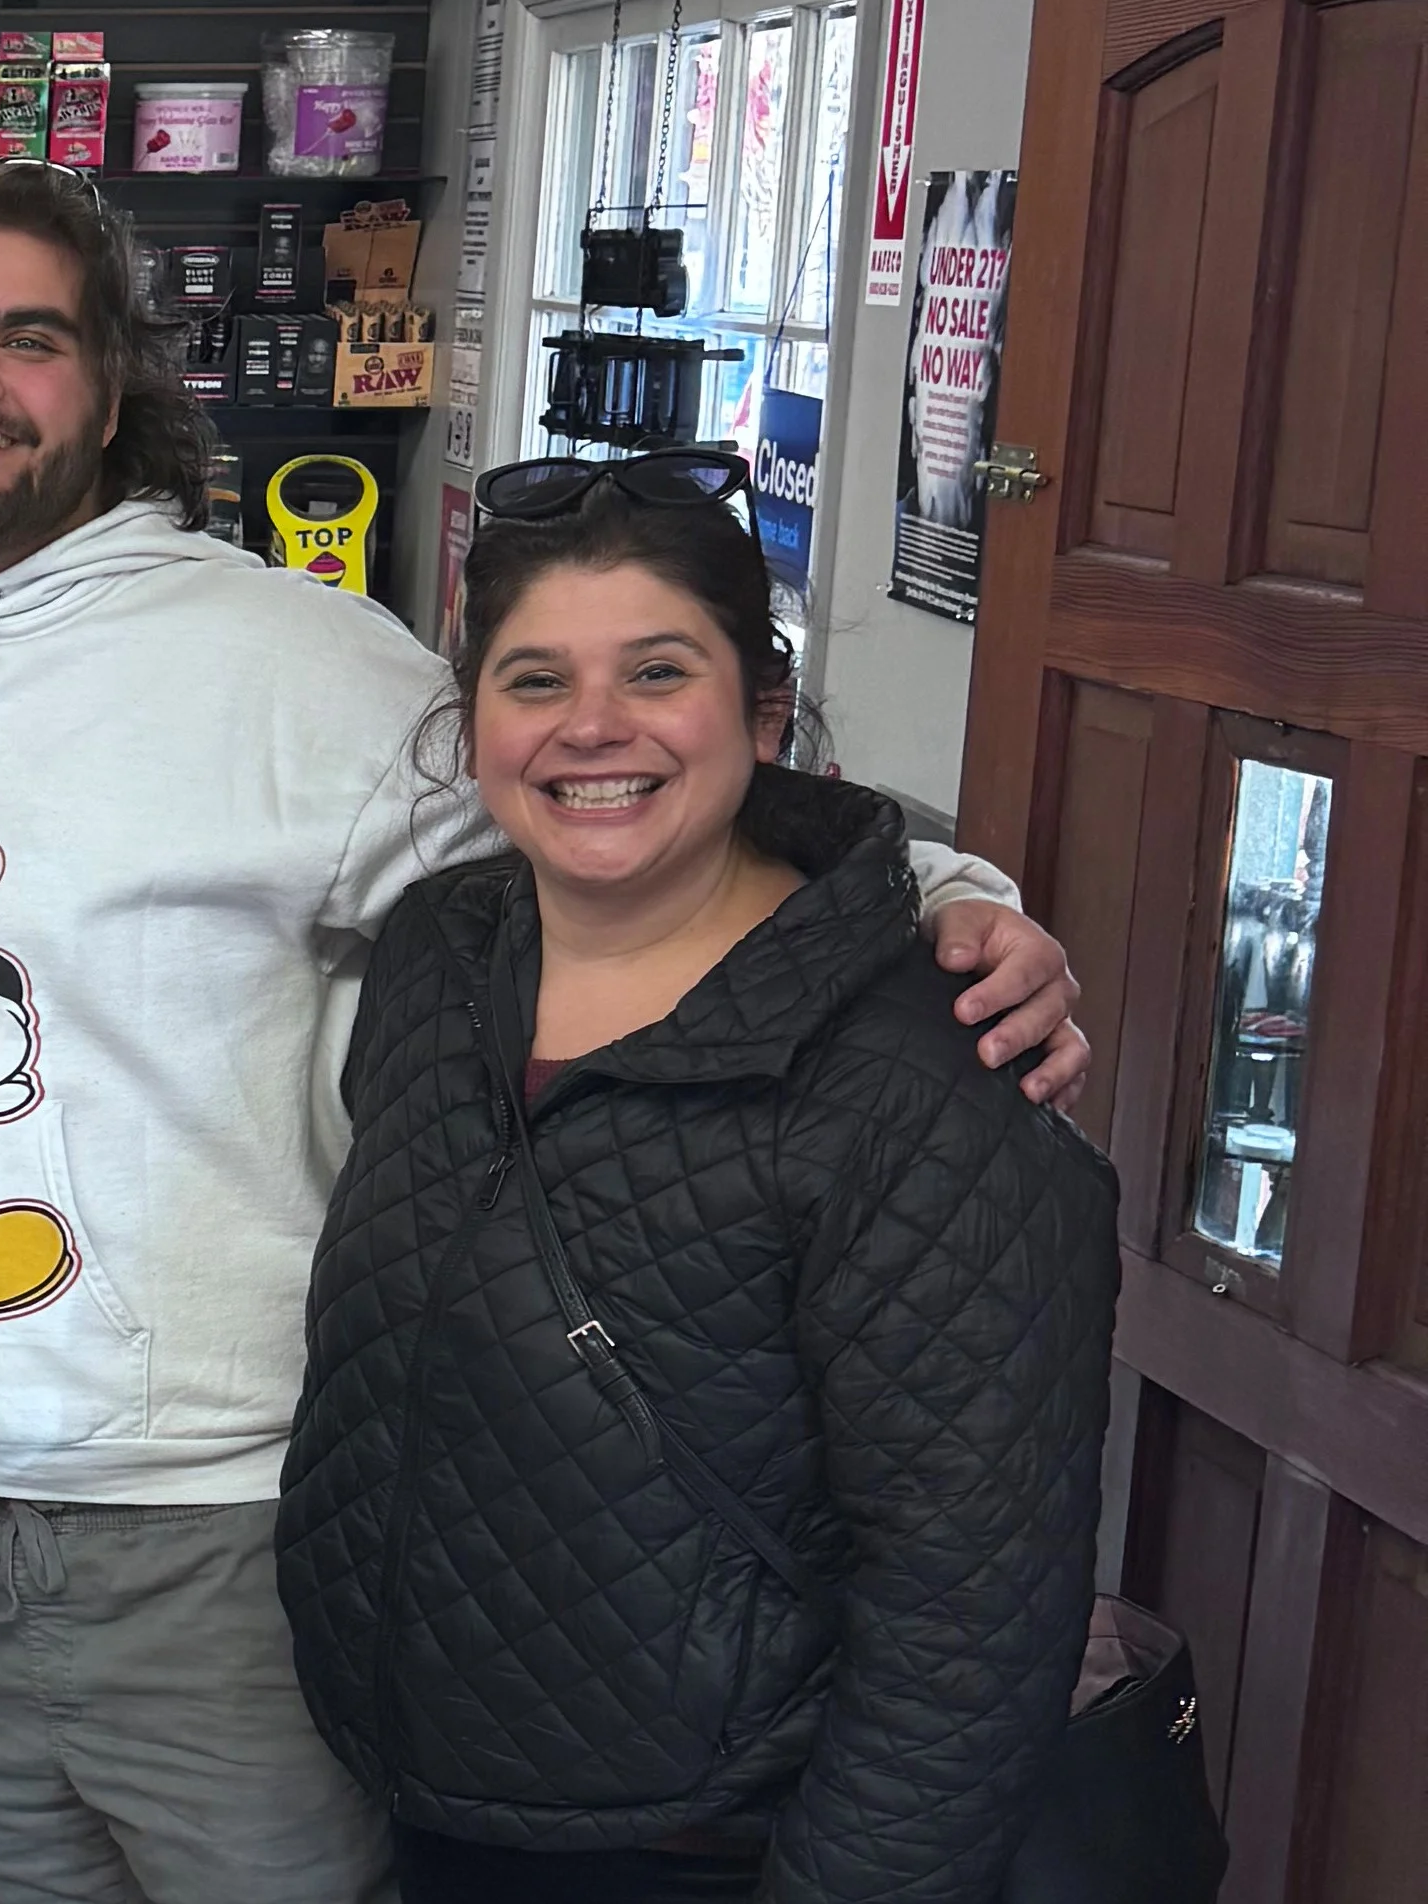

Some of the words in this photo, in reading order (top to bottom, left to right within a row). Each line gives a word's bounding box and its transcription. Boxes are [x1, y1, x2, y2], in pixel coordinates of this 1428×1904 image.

[313, 100, 342, 114] Happy
[930, 246, 976, 288] UNDER
[976, 248, 1007, 291] 21?
[925, 296, 948, 336] NO
[949, 297, 990, 341] SALE.
[353, 368, 421, 394] RAW
[921, 344, 943, 385] NO
[947, 347, 984, 391] WAY.
[756, 437, 820, 508] Closed
[295, 527, 353, 549] TOP
